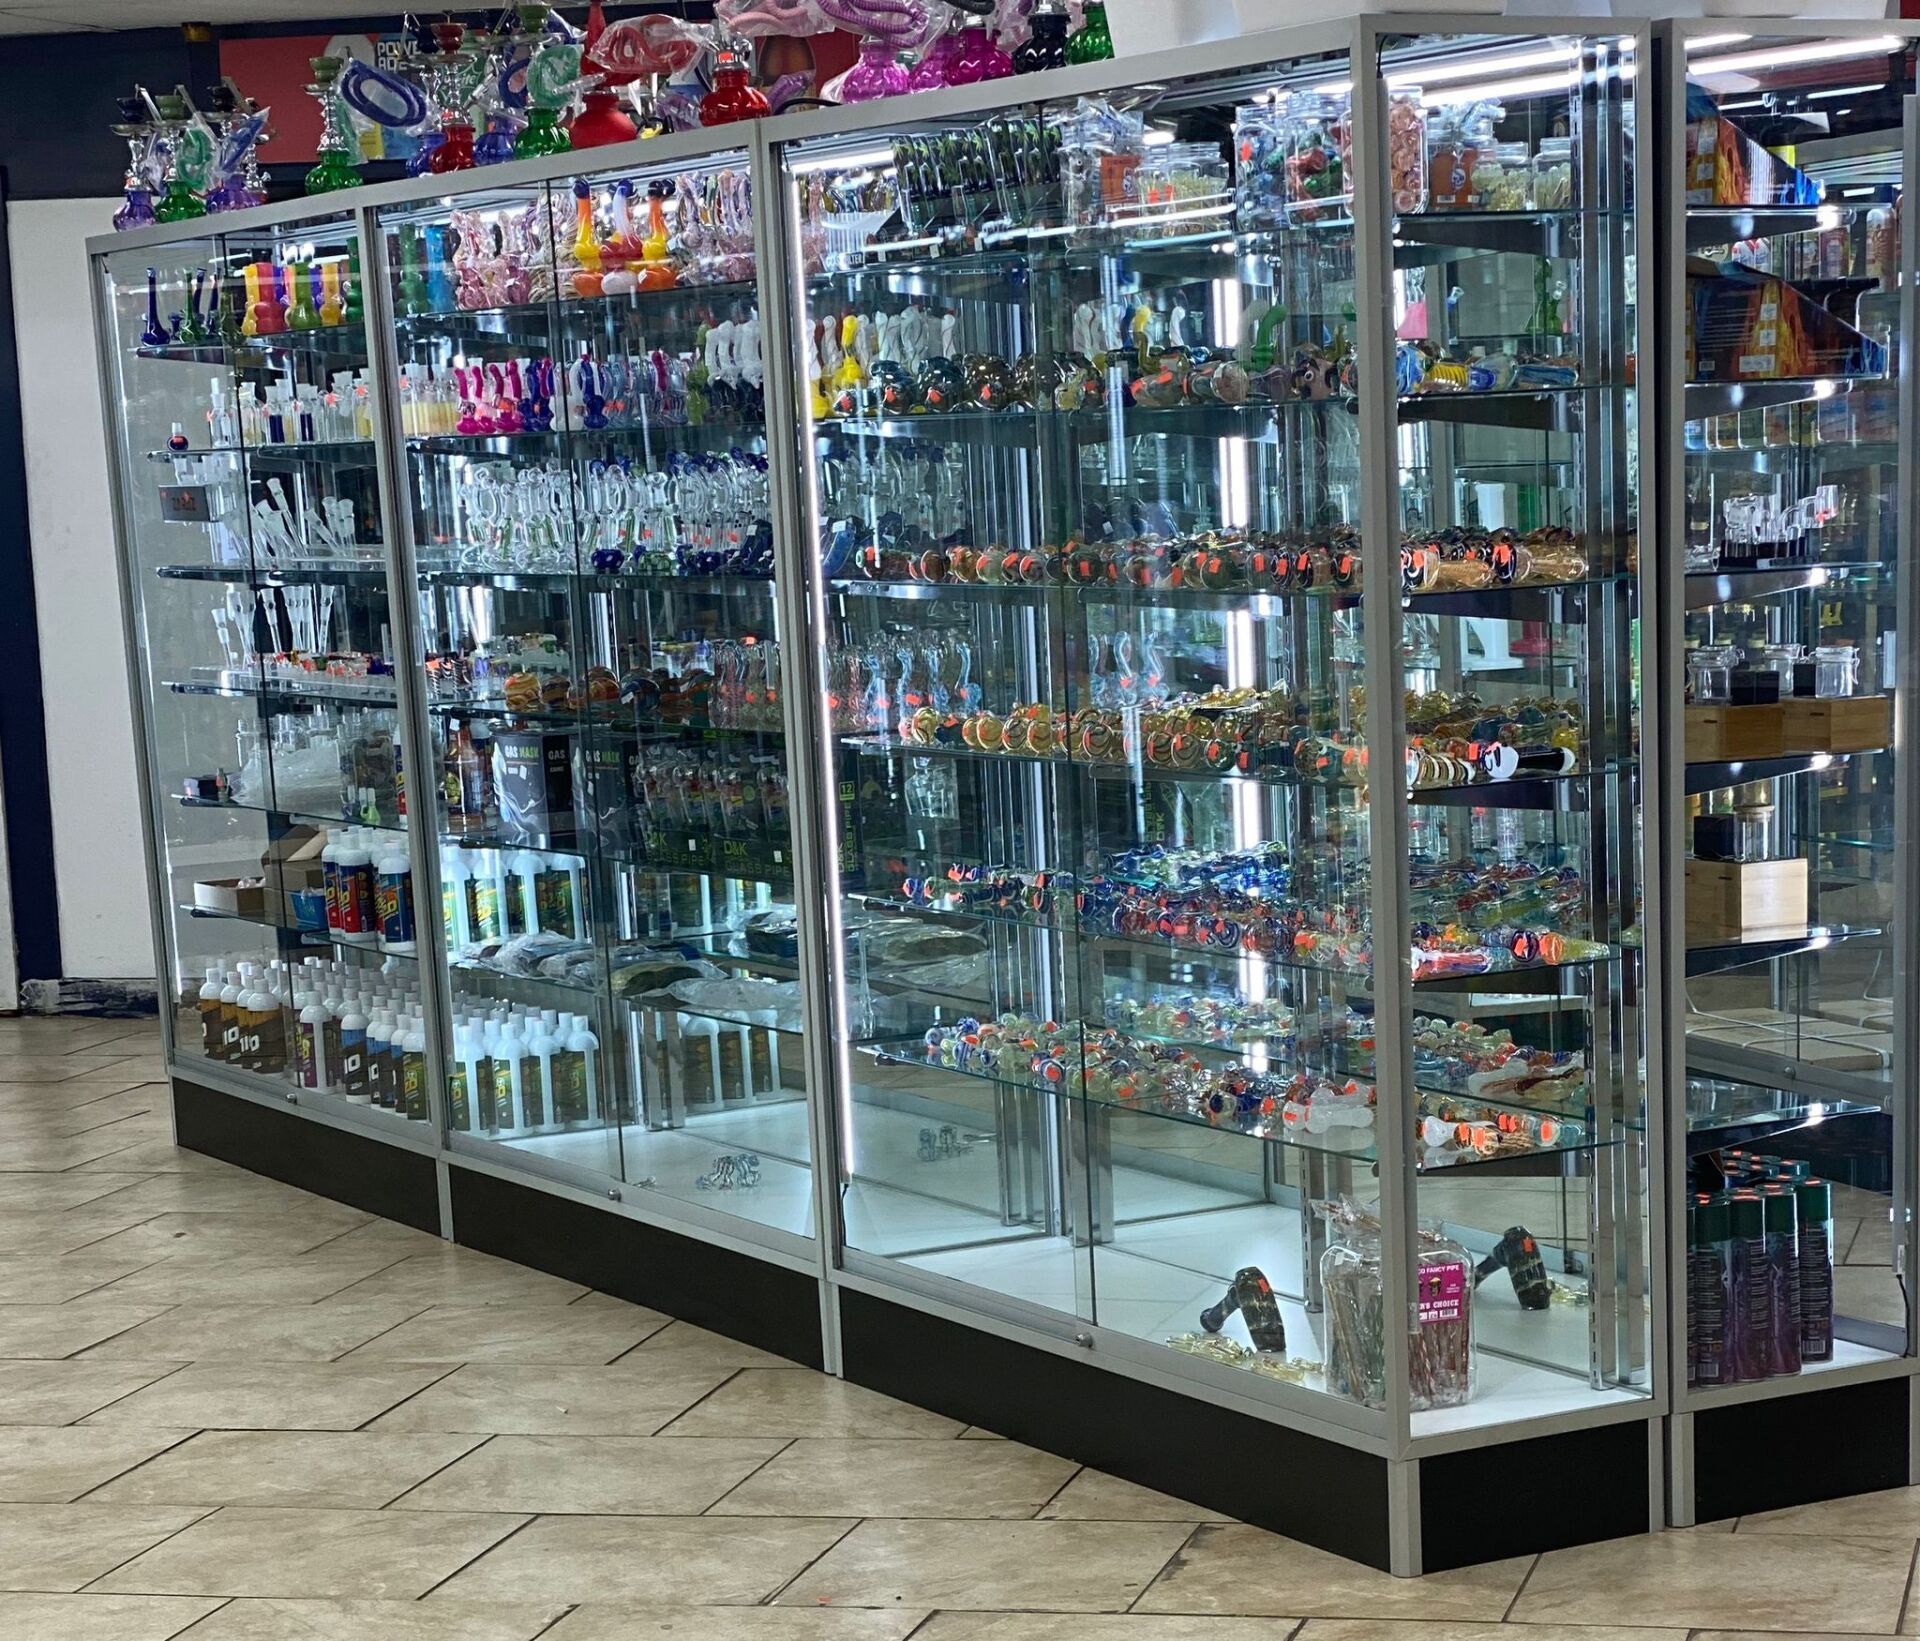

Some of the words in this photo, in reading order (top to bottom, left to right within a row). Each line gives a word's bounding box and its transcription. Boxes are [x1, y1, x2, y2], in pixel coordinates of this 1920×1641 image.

[377, 41, 421, 56] POWE
[504, 745, 518, 758] GAS
[548, 750, 566, 760] GAS
[723, 840, 747, 856] D&K
[725, 861, 762, 874] GLASS
[764, 864, 791, 877] PIPE
[1433, 1300, 1459, 1308] CHOICE
